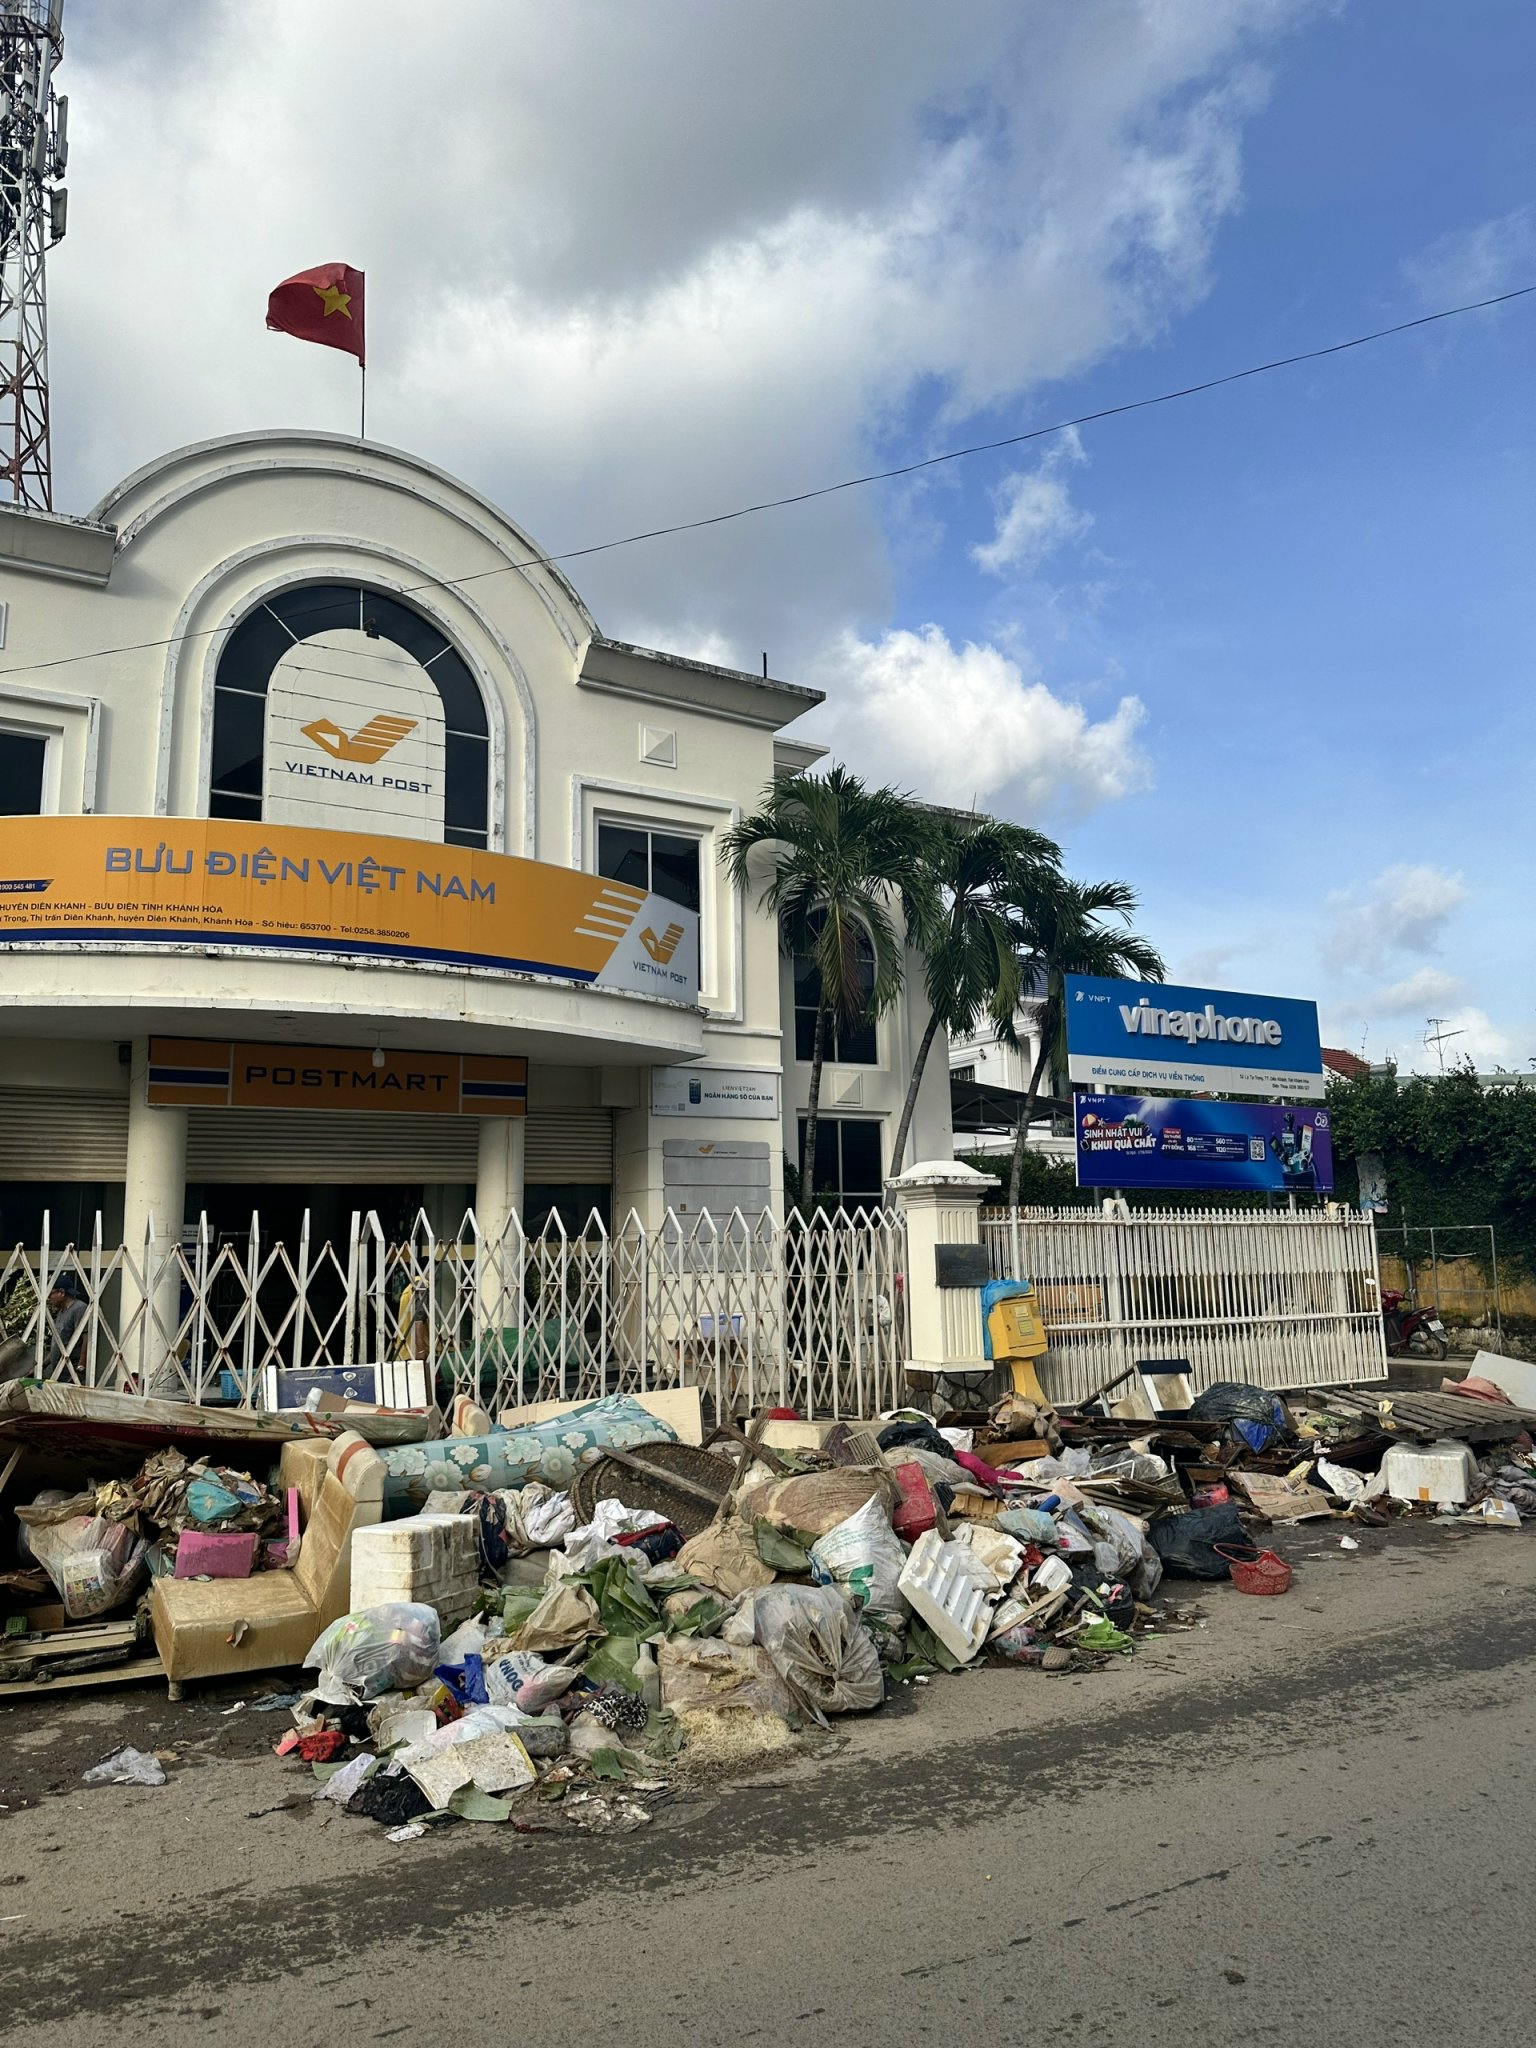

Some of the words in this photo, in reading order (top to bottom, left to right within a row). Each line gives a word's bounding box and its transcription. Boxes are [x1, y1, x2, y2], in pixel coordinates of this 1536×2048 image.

[285, 761, 373, 785] VIETNAM
[382, 776, 432, 794] POST
[105, 842, 193, 874] BƯU
[204, 846, 309, 885] ĐIỆN
[317, 856, 406, 894] VIỆT
[416, 870, 496, 905] NAM
[25, 882, 36, 890] 481
[54, 902, 86, 910] KHÁNH
[165, 902, 200, 913] KHÁNH
[202, 904, 223, 913] HÒA
[299, 922, 332, 932] 653700
[632, 960, 668, 978] VIETNAM
[669, 971, 687, 984] POST
[1088, 994, 1112, 1004] VNPT
[1118, 997, 1283, 1045] vinaphone
[246, 1065, 449, 1092] POSTMART
[1108, 1067, 1126, 1077] CUNG
[1128, 1067, 1141, 1078] CẤP
[1084, 1128, 1104, 1139] SINH
[1105, 1126, 1128, 1139] NHẬT
[1128, 1127, 1143, 1137] VUI
[1091, 1139, 1113, 1151] KHUI
[1113, 1136, 1133, 1152] QUÀ
[1134, 1133, 1157, 1149] CHẤT
